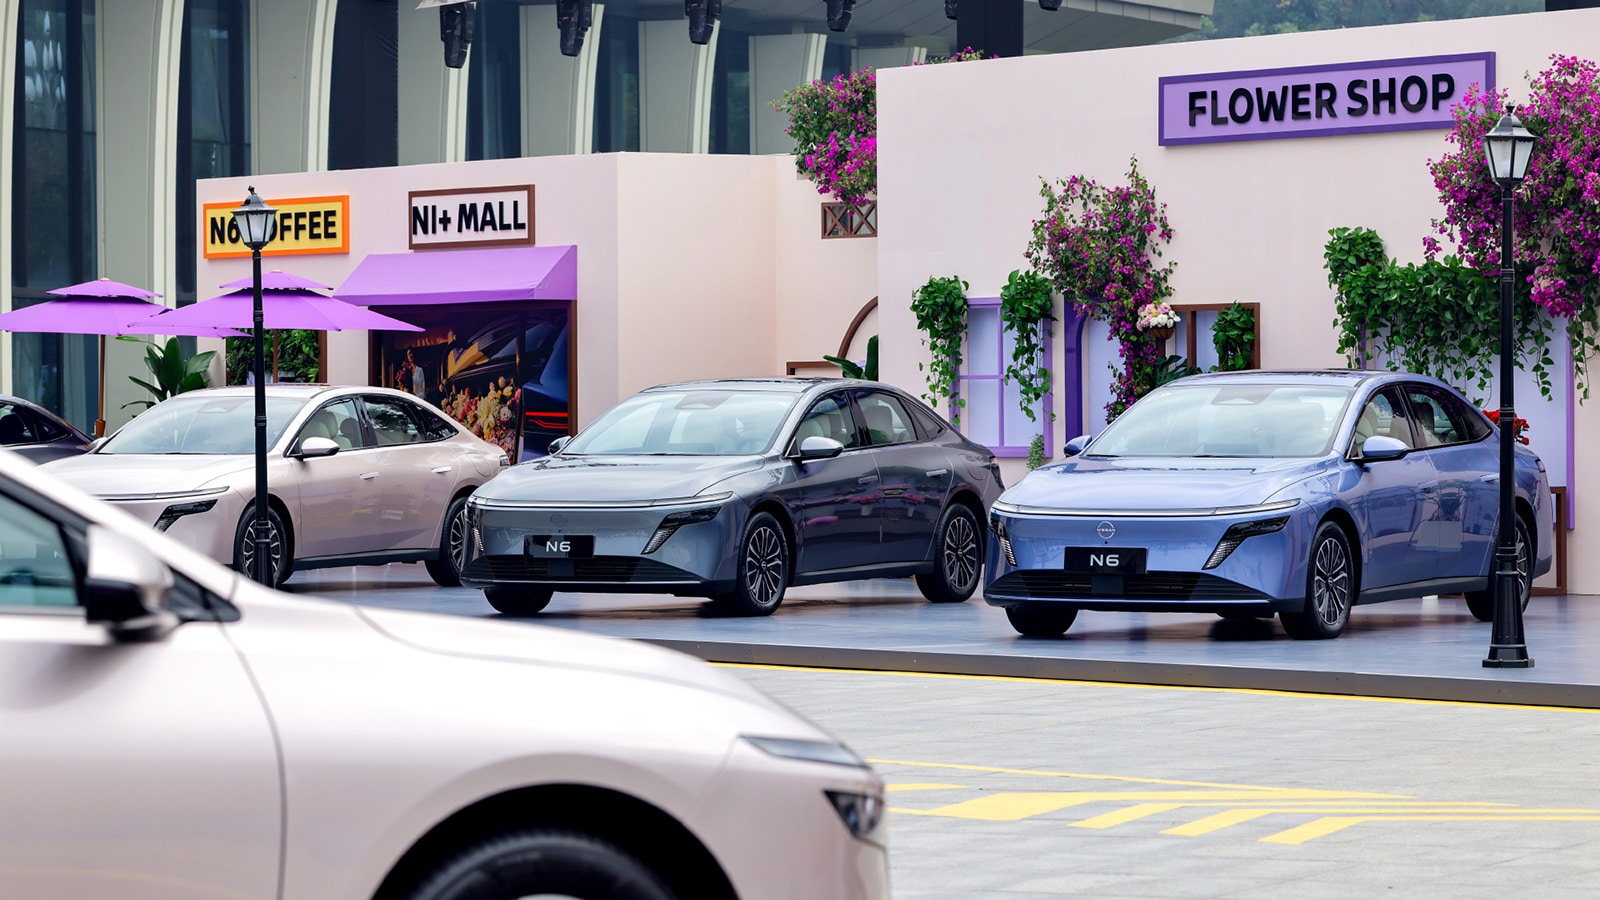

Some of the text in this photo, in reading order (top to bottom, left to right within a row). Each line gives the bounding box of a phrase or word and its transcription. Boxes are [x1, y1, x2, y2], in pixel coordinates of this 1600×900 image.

[1188, 73, 1455, 127] FLOWER SHOP
[210, 210, 337, 244] N6 FFEE
[412, 200, 526, 236] NI+ MALL
[545, 541, 571, 552] N6
[1089, 554, 1120, 567] N6
